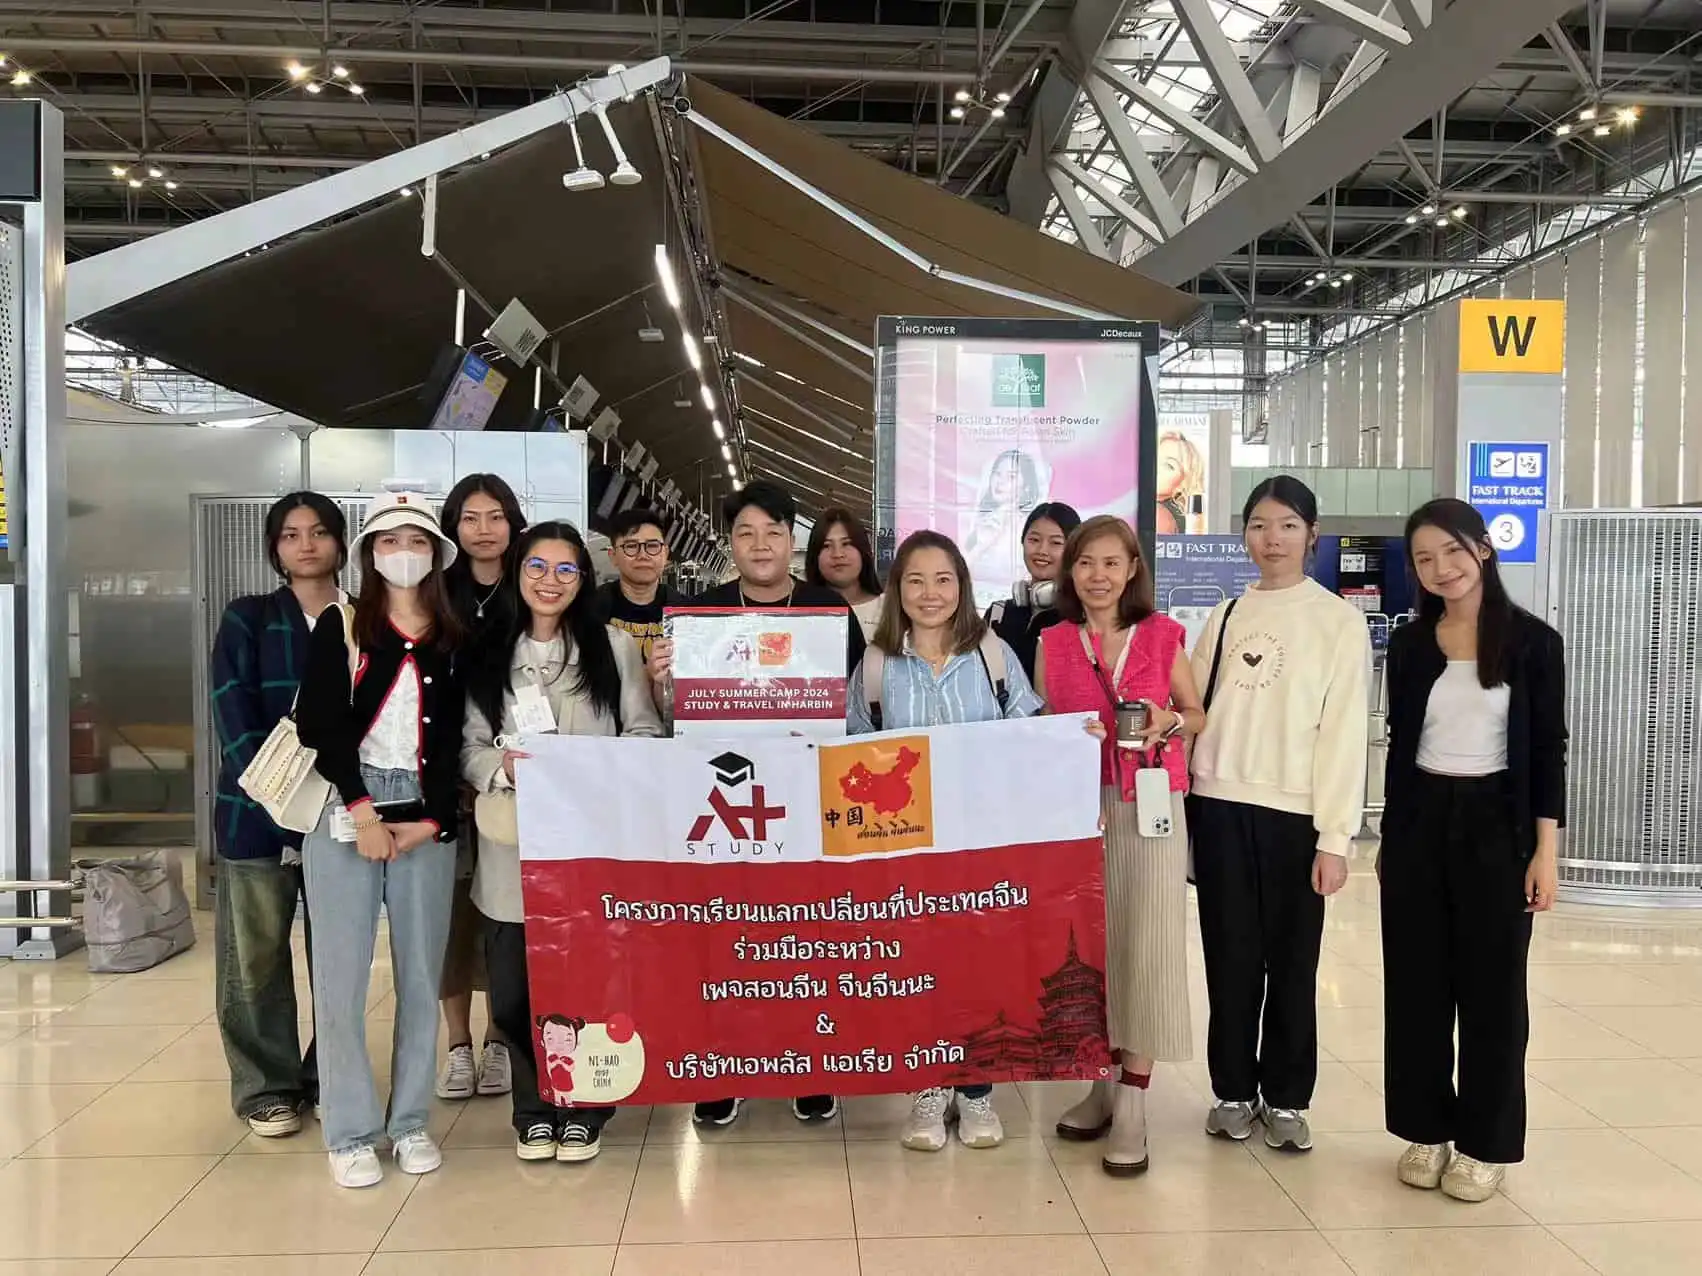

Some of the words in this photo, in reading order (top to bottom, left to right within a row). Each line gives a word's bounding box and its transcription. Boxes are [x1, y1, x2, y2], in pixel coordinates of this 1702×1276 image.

[896, 325, 920, 334] KING
[922, 325, 956, 334] POWER
[1101, 329, 1142, 338] JCDecaux
[1487, 316, 1537, 357] W
[936, 415, 992, 425] Perfecting
[1060, 414, 1101, 425] Powder
[1472, 485, 1499, 496] FAST
[1503, 485, 1544, 496] TRACK
[1499, 521, 1514, 543] 3
[1186, 543, 1217, 553] FAST
[1219, 543, 1248, 553] TRA
[688, 688, 717, 698] JULY
[719, 687, 767, 698] SUMMER
[771, 688, 801, 697] CAMP
[803, 688, 829, 697] 2024
[684, 700, 720, 710] STUDY
[723, 701, 730, 709] &
[733, 700, 774, 709] TRAVEL
[791, 700, 833, 709] HARBIN
[825, 807, 864, 829] 中国
[687, 841, 785, 856] STUDY
[601, 881, 1029, 923] โครงการเรียนแลกเปลี่ยนที่ประเทศจีน
[733, 934, 901, 961] ร่วมมือระหว่าง
[702, 973, 828, 1000] เพจสอนจีน
[838, 971, 937, 1000] จีนจีนนะ
[815, 1013, 835, 1034] &
[588, 1054, 620, 1067] NI-HAO
[665, 1050, 812, 1079] บริษัทเอพลัส
[822, 1048, 892, 1073] แอเรีย
[904, 1039, 965, 1070] จำกัด
